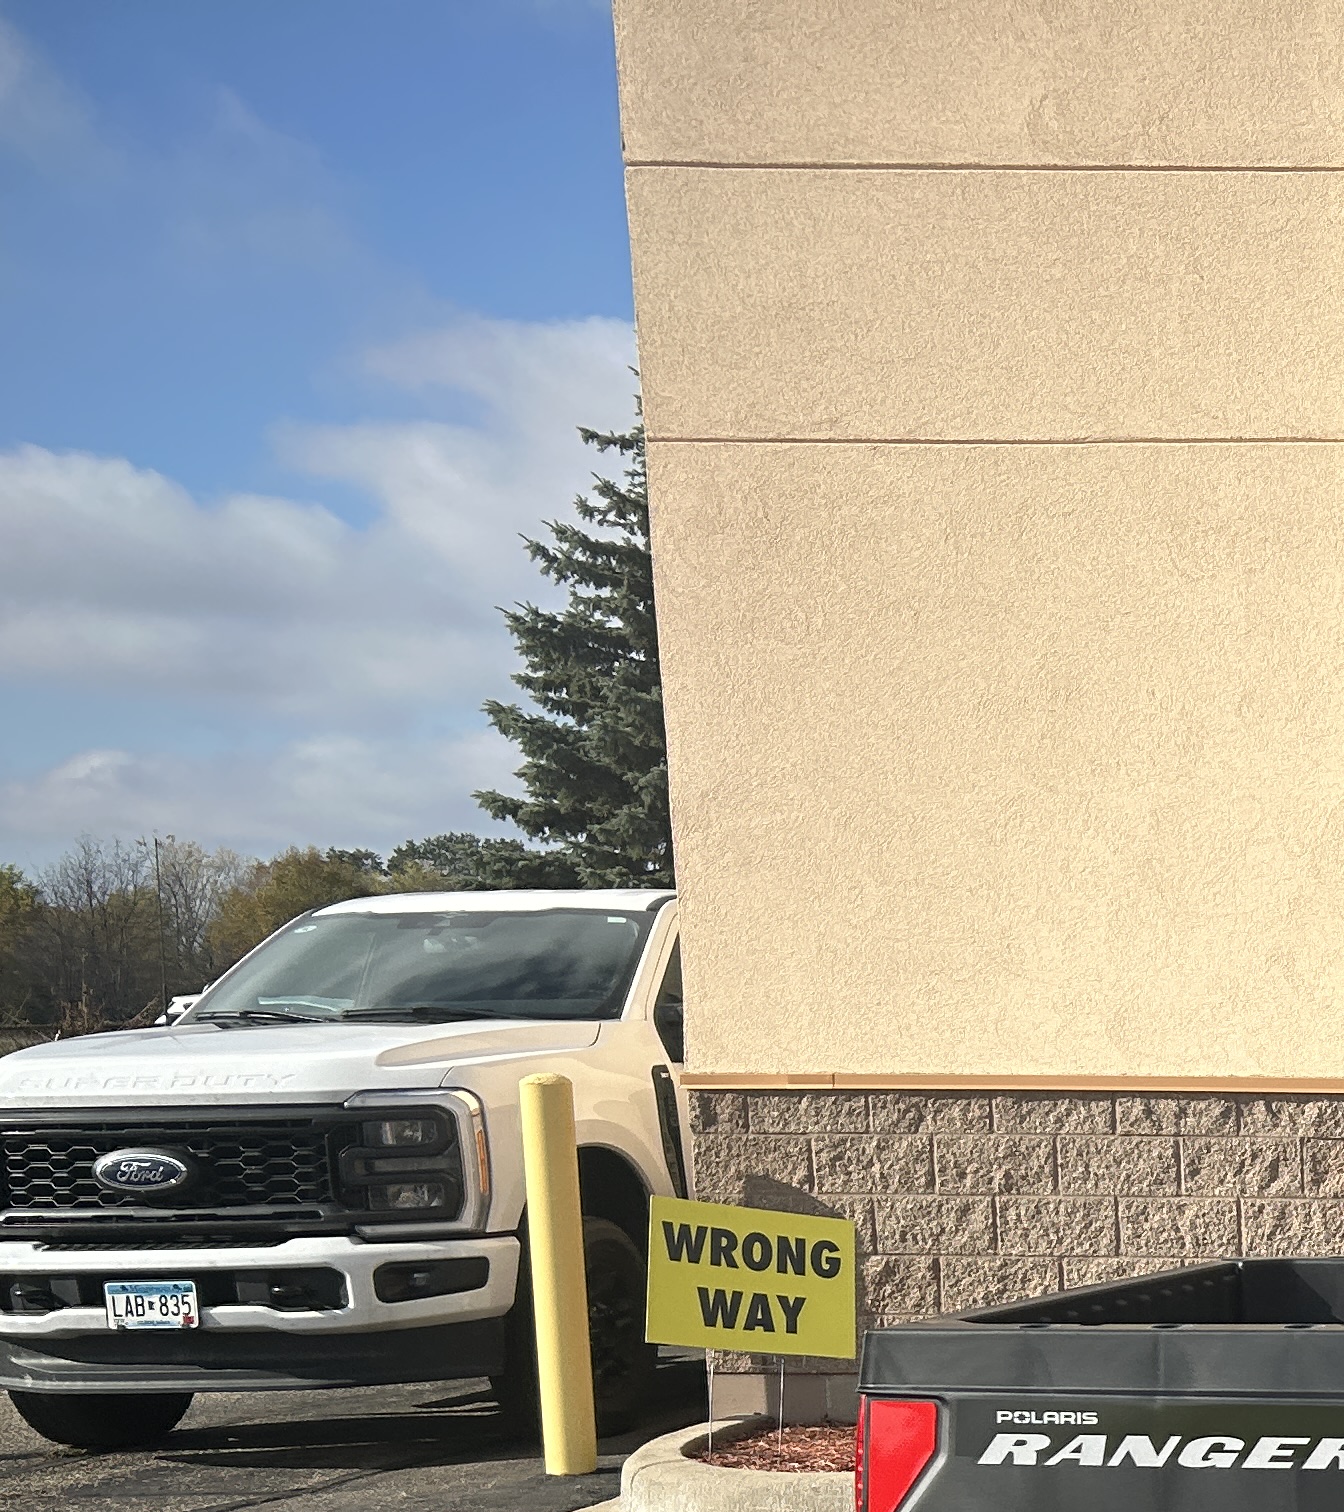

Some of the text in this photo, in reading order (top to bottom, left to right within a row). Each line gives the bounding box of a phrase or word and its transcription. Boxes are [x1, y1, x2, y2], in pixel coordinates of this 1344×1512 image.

[170, 1073, 297, 1089] DUTY
[116, 1161, 164, 1183] Ford
[662, 1220, 842, 1279] WRONG
[112, 1294, 192, 1318] LAB 835
[697, 1286, 807, 1335] WAY
[996, 1410, 1099, 1425] POLARIS
